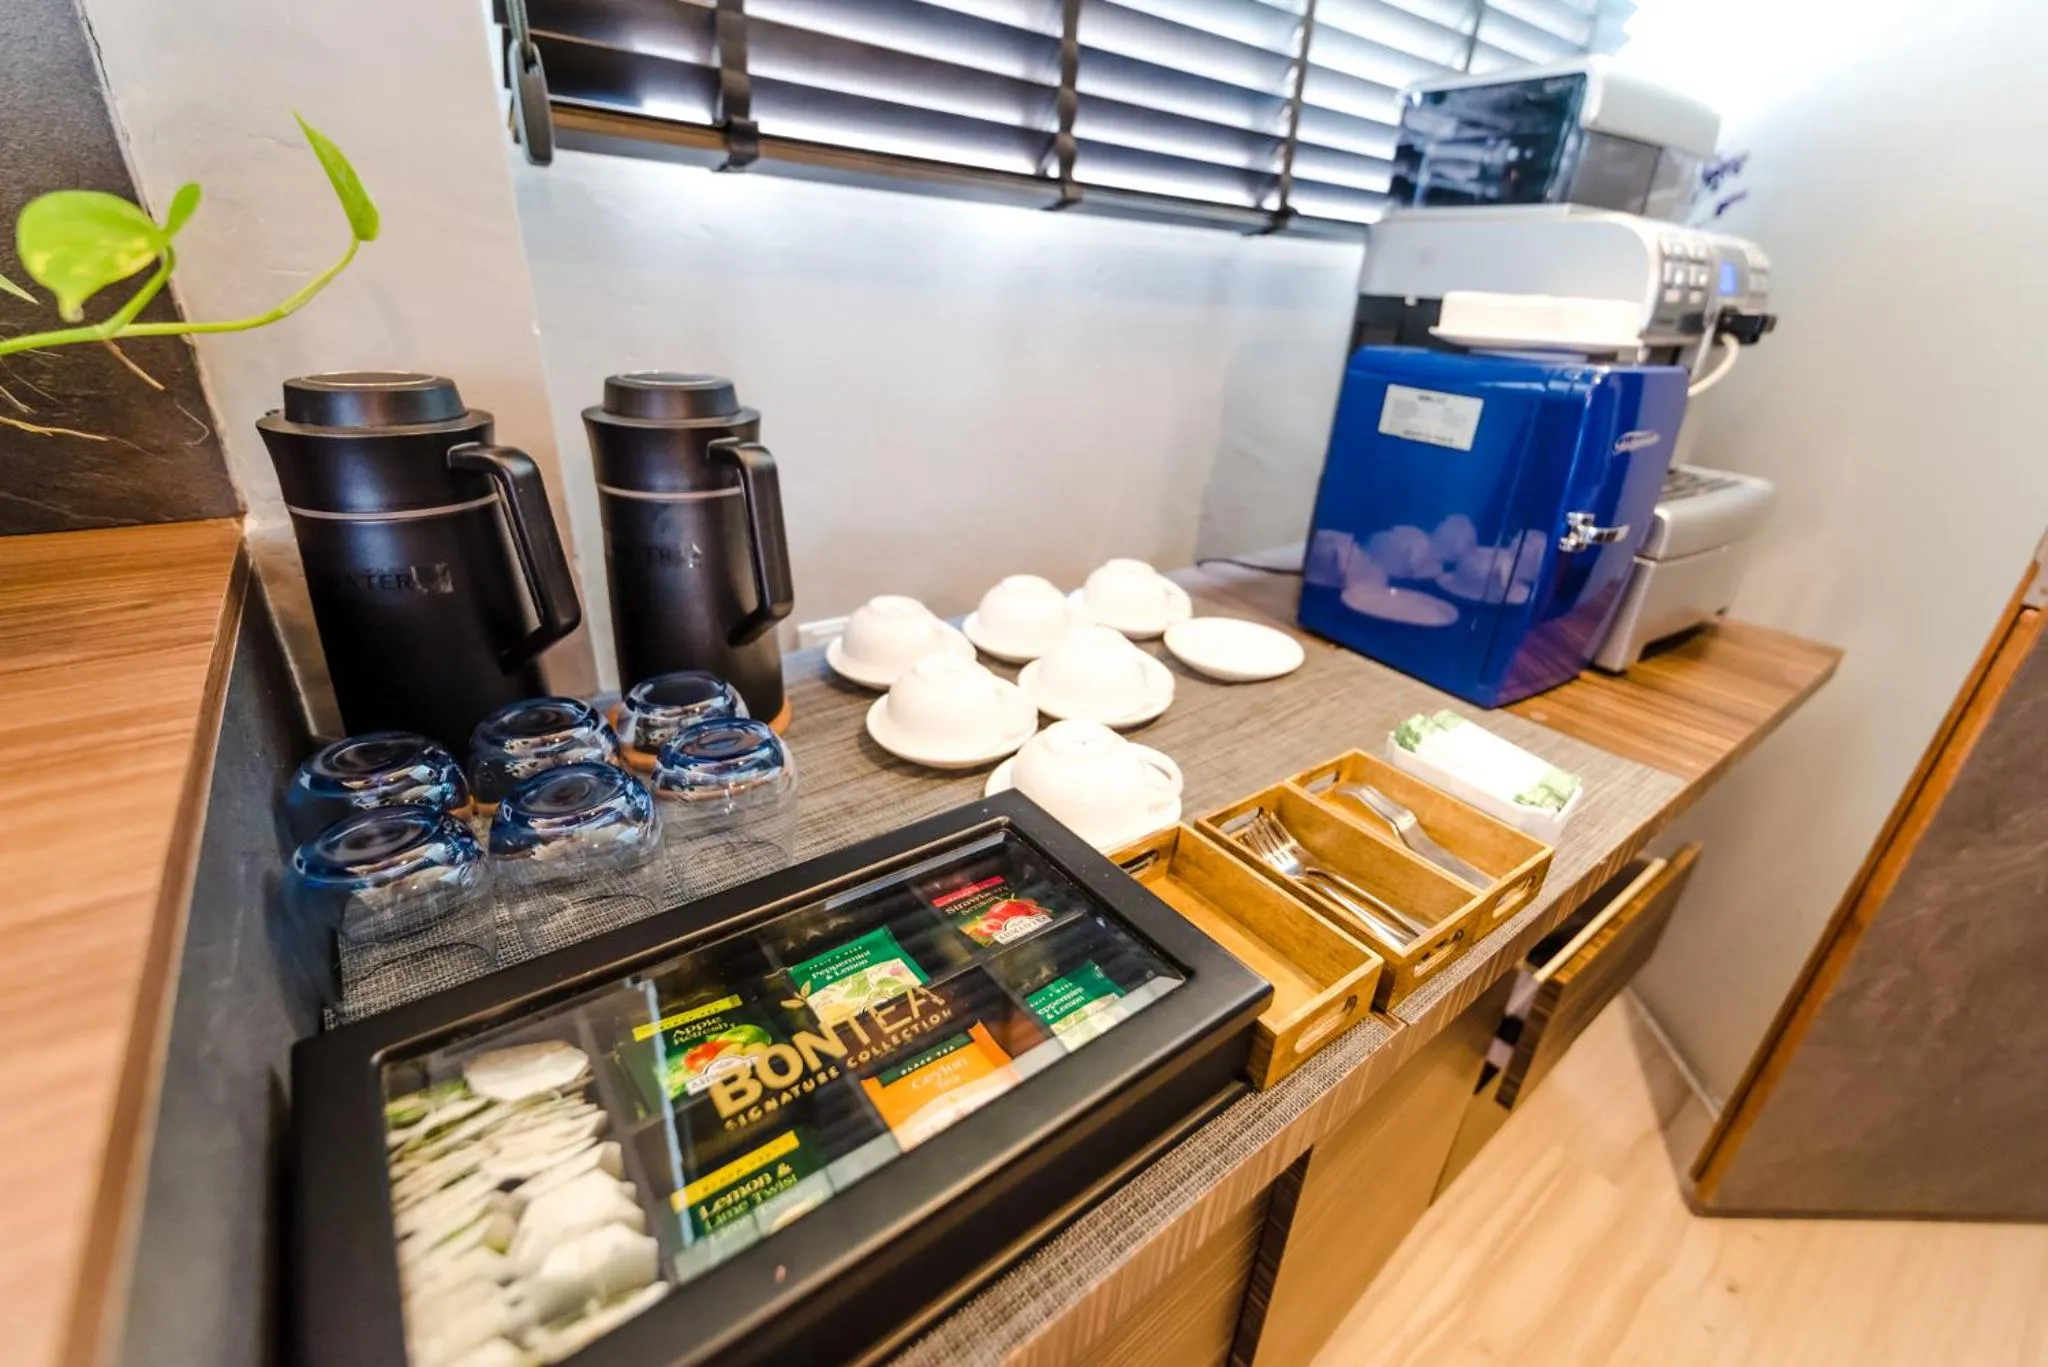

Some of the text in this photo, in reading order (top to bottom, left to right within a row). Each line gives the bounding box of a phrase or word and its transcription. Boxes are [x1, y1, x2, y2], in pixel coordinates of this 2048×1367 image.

[811, 950, 872, 979] Peppermint
[834, 959, 869, 977] Lemon
[672, 1016, 722, 1039] Apple
[724, 1008, 952, 1131] SIGNATURE COLLECTION
[699, 1172, 773, 1221] Lemon
